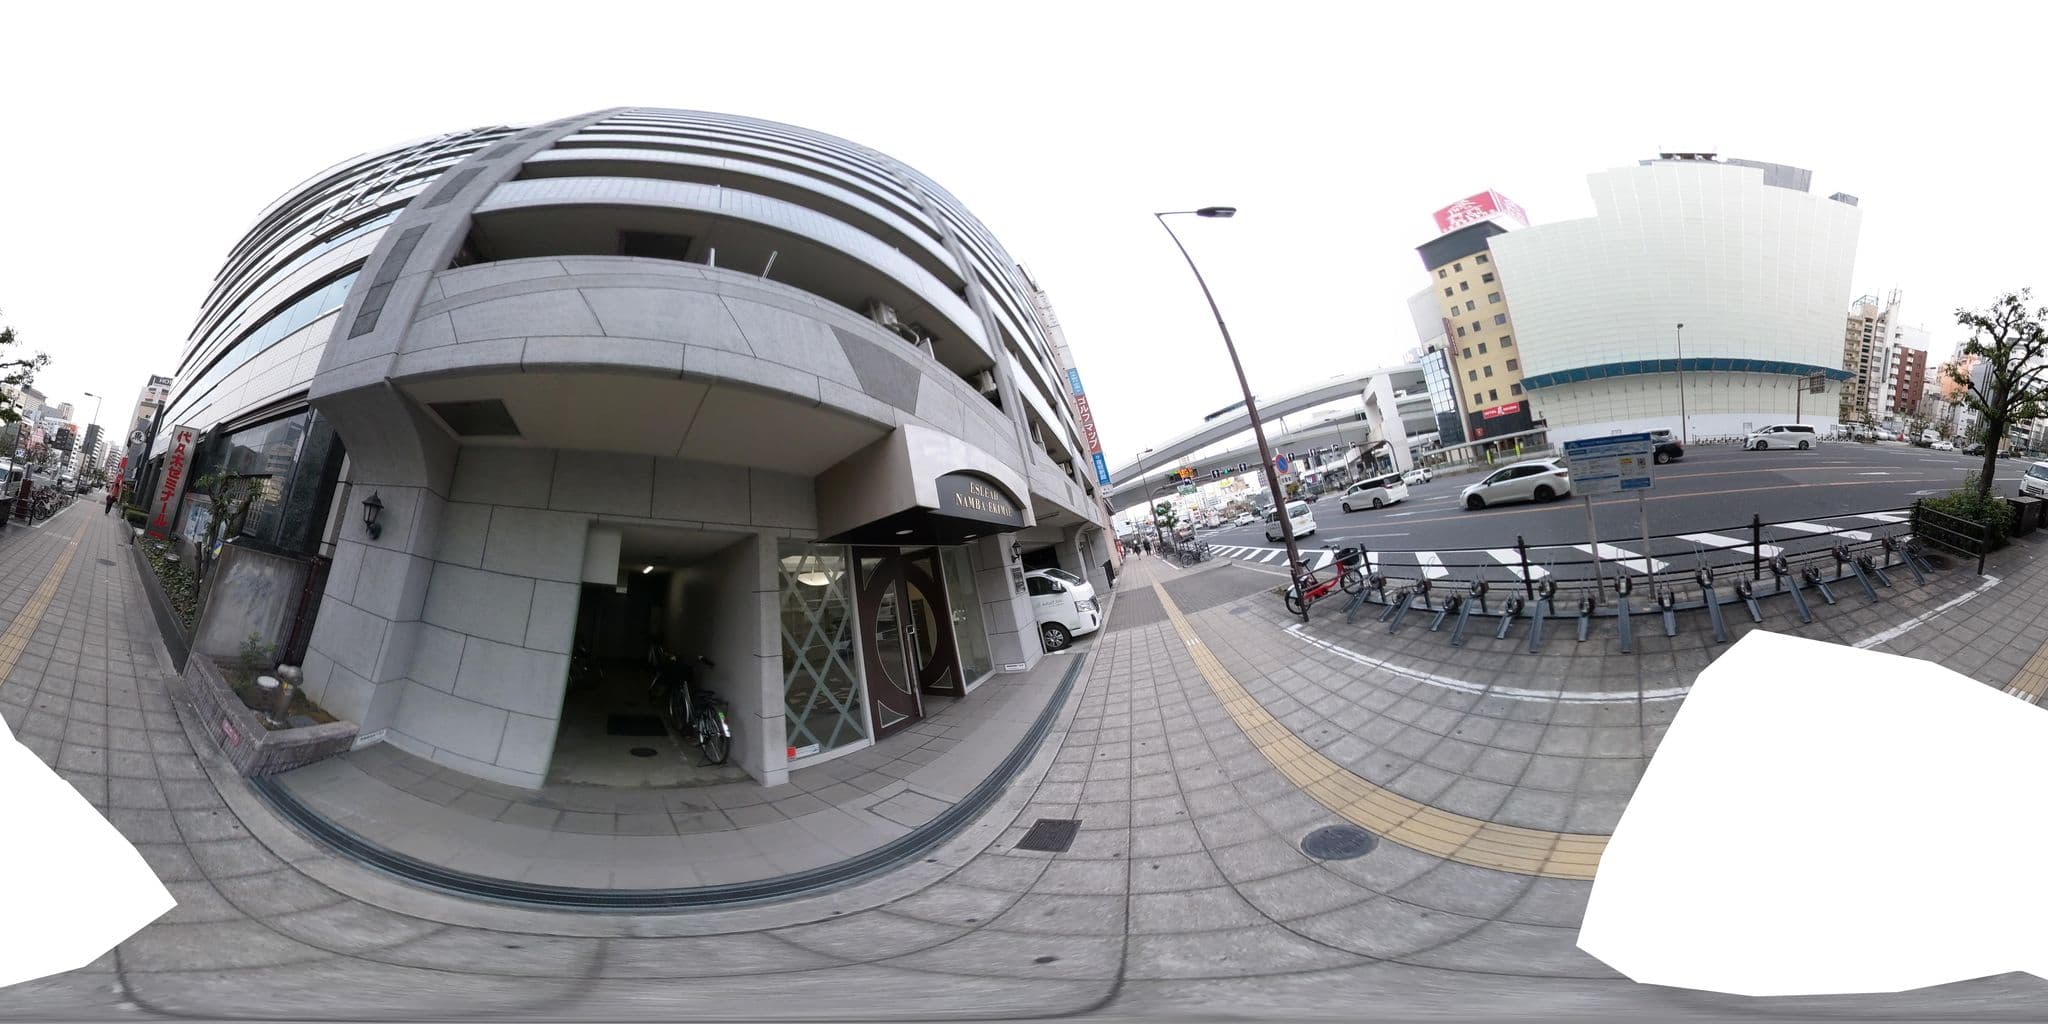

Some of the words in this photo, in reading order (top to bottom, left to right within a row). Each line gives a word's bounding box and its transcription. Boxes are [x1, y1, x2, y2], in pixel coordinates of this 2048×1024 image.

[152, 430, 193, 528] 代々木ゼミナール
[970, 482, 999, 501] ESLEAD
[955, 492, 986, 512] NAMBA
